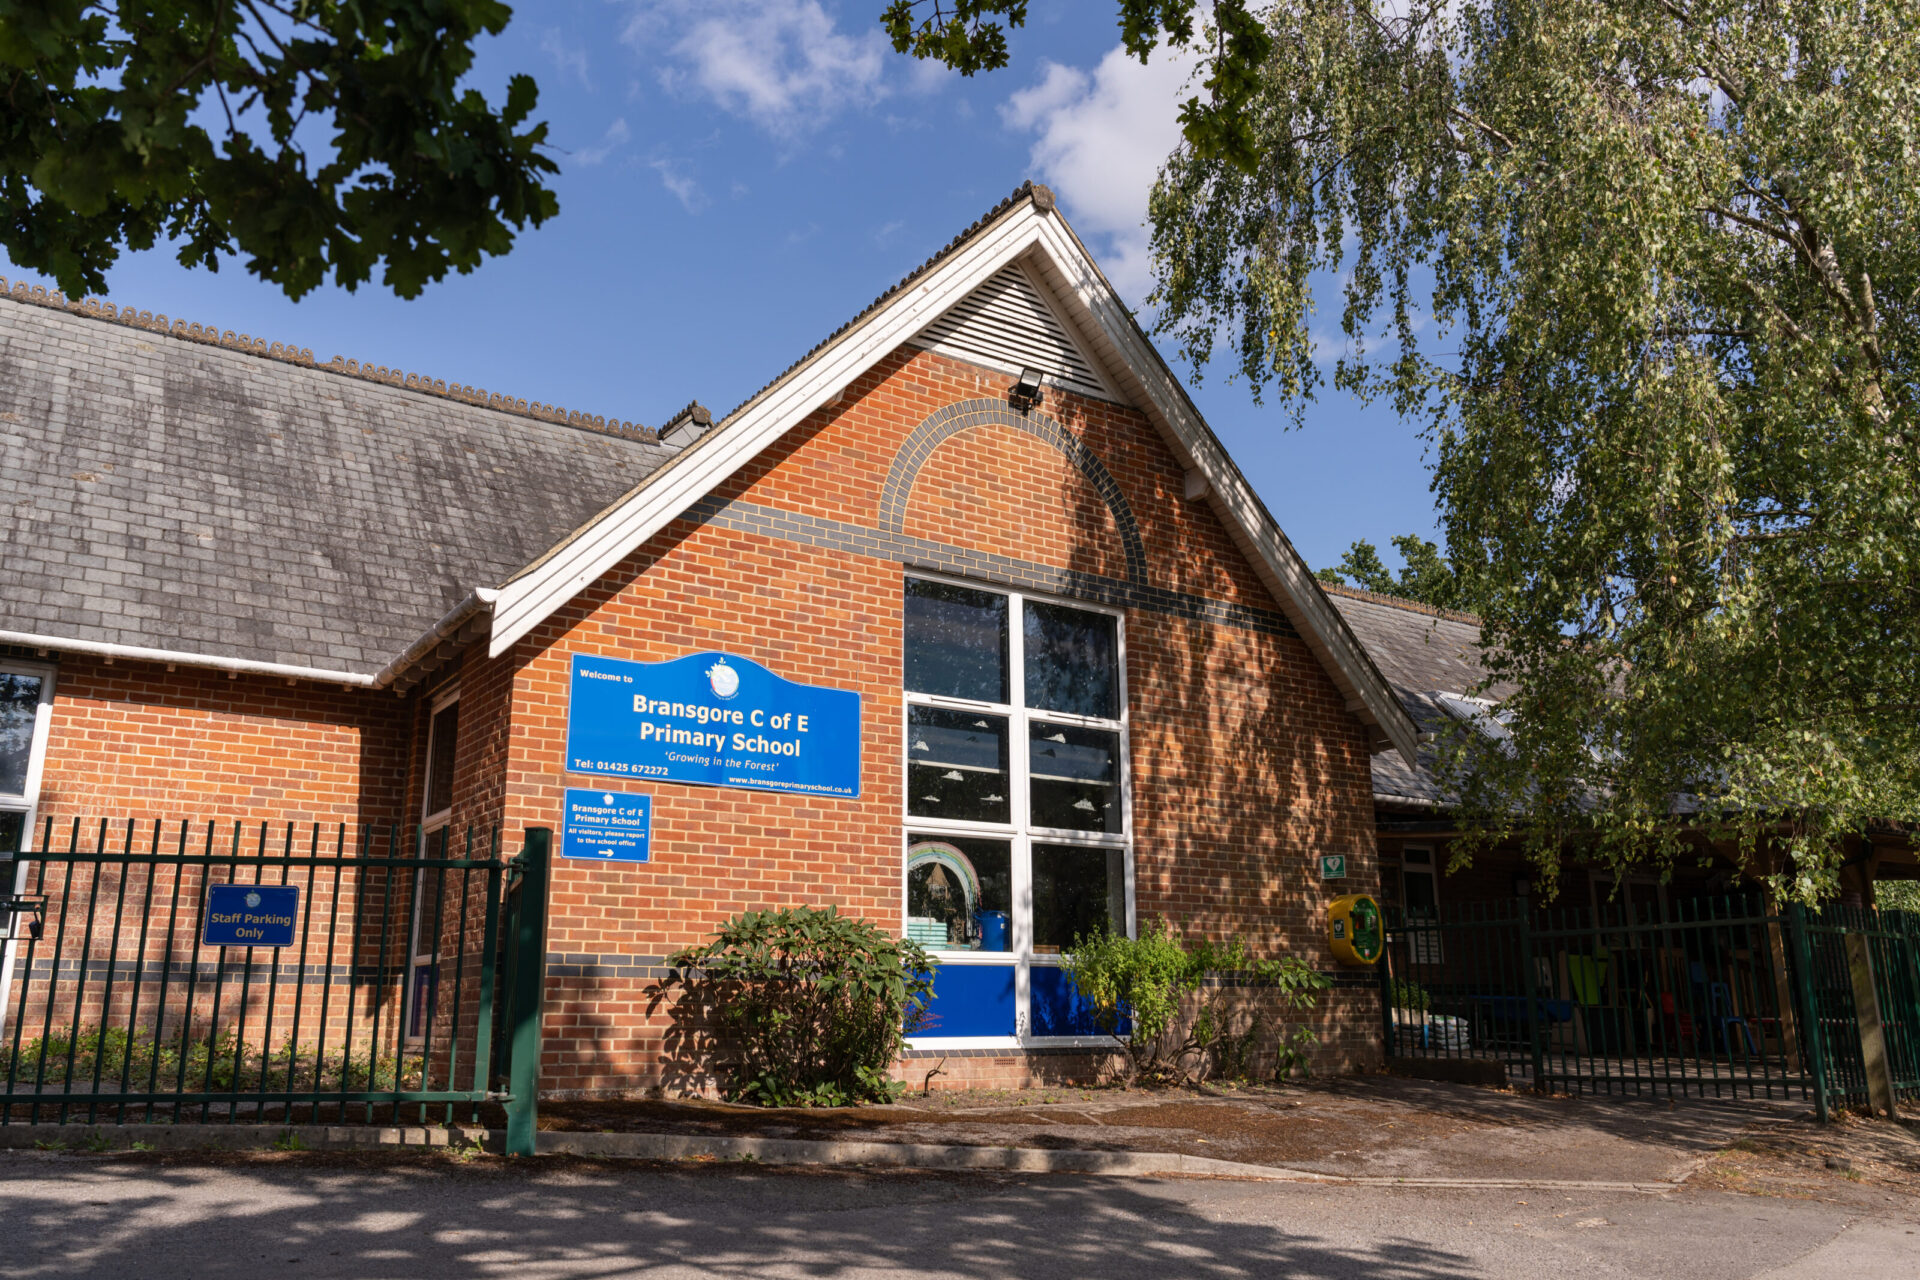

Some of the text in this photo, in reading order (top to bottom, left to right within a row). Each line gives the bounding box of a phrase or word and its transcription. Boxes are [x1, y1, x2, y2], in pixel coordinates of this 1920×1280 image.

[580, 669, 621, 682] Welcome
[633, 694, 744, 724] Bransgore
[750, 709, 764, 727] C
[770, 712, 792, 730] of
[798, 714, 808, 732] E
[640, 722, 800, 757] Primary School
[574, 758, 668, 776] Tel: 01425 672272
[713, 756, 722, 766] in
[726, 758, 742, 768] the
[728, 776, 852, 794] www.bransgoreprimaryschool.co.uk
[572, 804, 616, 815] Bransgore
[575, 814, 640, 826] Primary School
[211, 913, 291, 926] Staff Parking
[236, 928, 264, 940] Only
